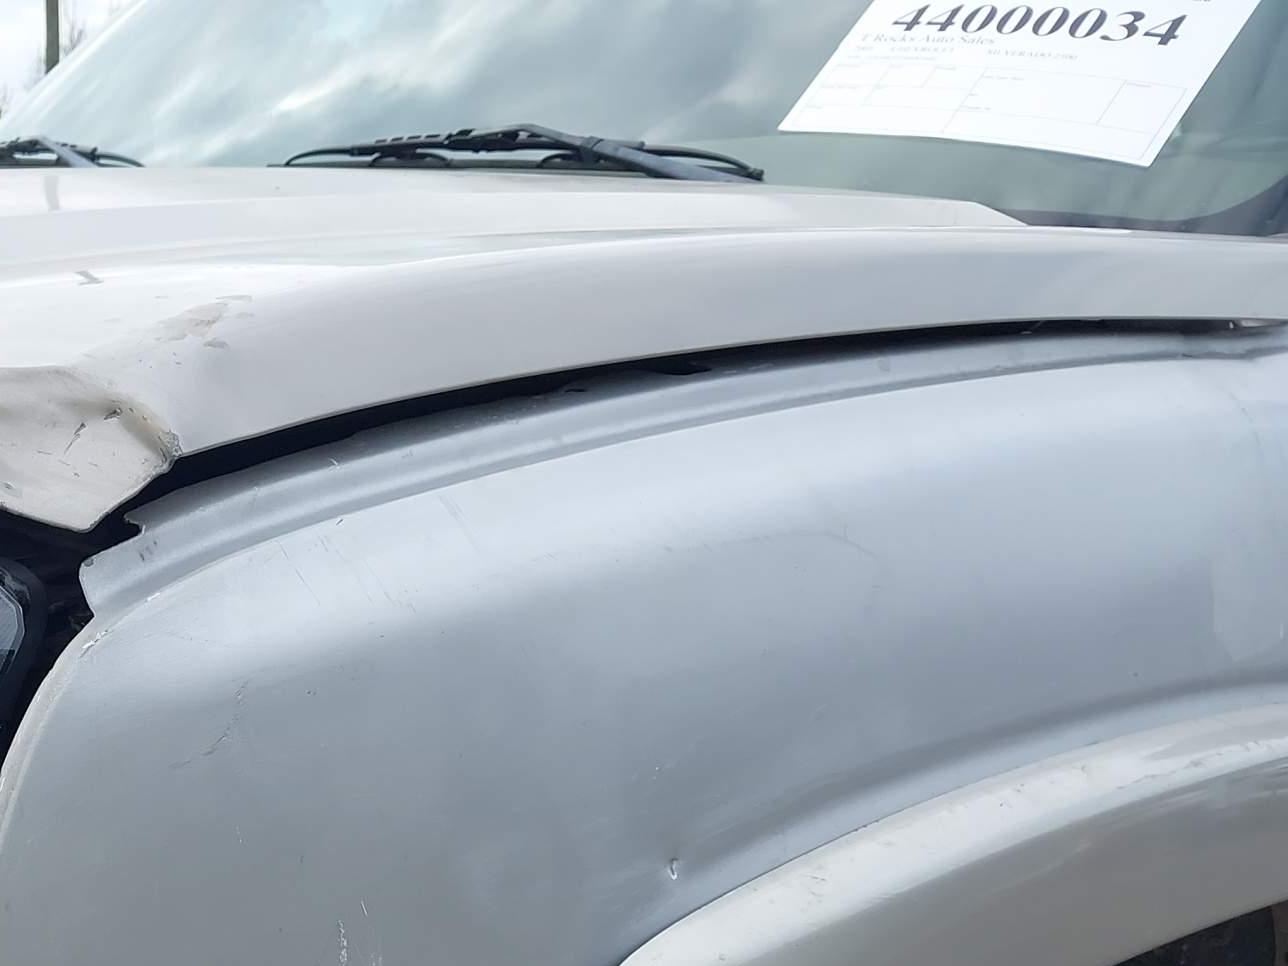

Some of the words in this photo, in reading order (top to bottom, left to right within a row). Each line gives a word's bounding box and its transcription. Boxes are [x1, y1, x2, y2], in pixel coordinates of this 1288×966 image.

[891, 4, 1188, 46] 44000034
[919, 34, 955, 43] Auto
[959, 35, 996, 45] Sales
